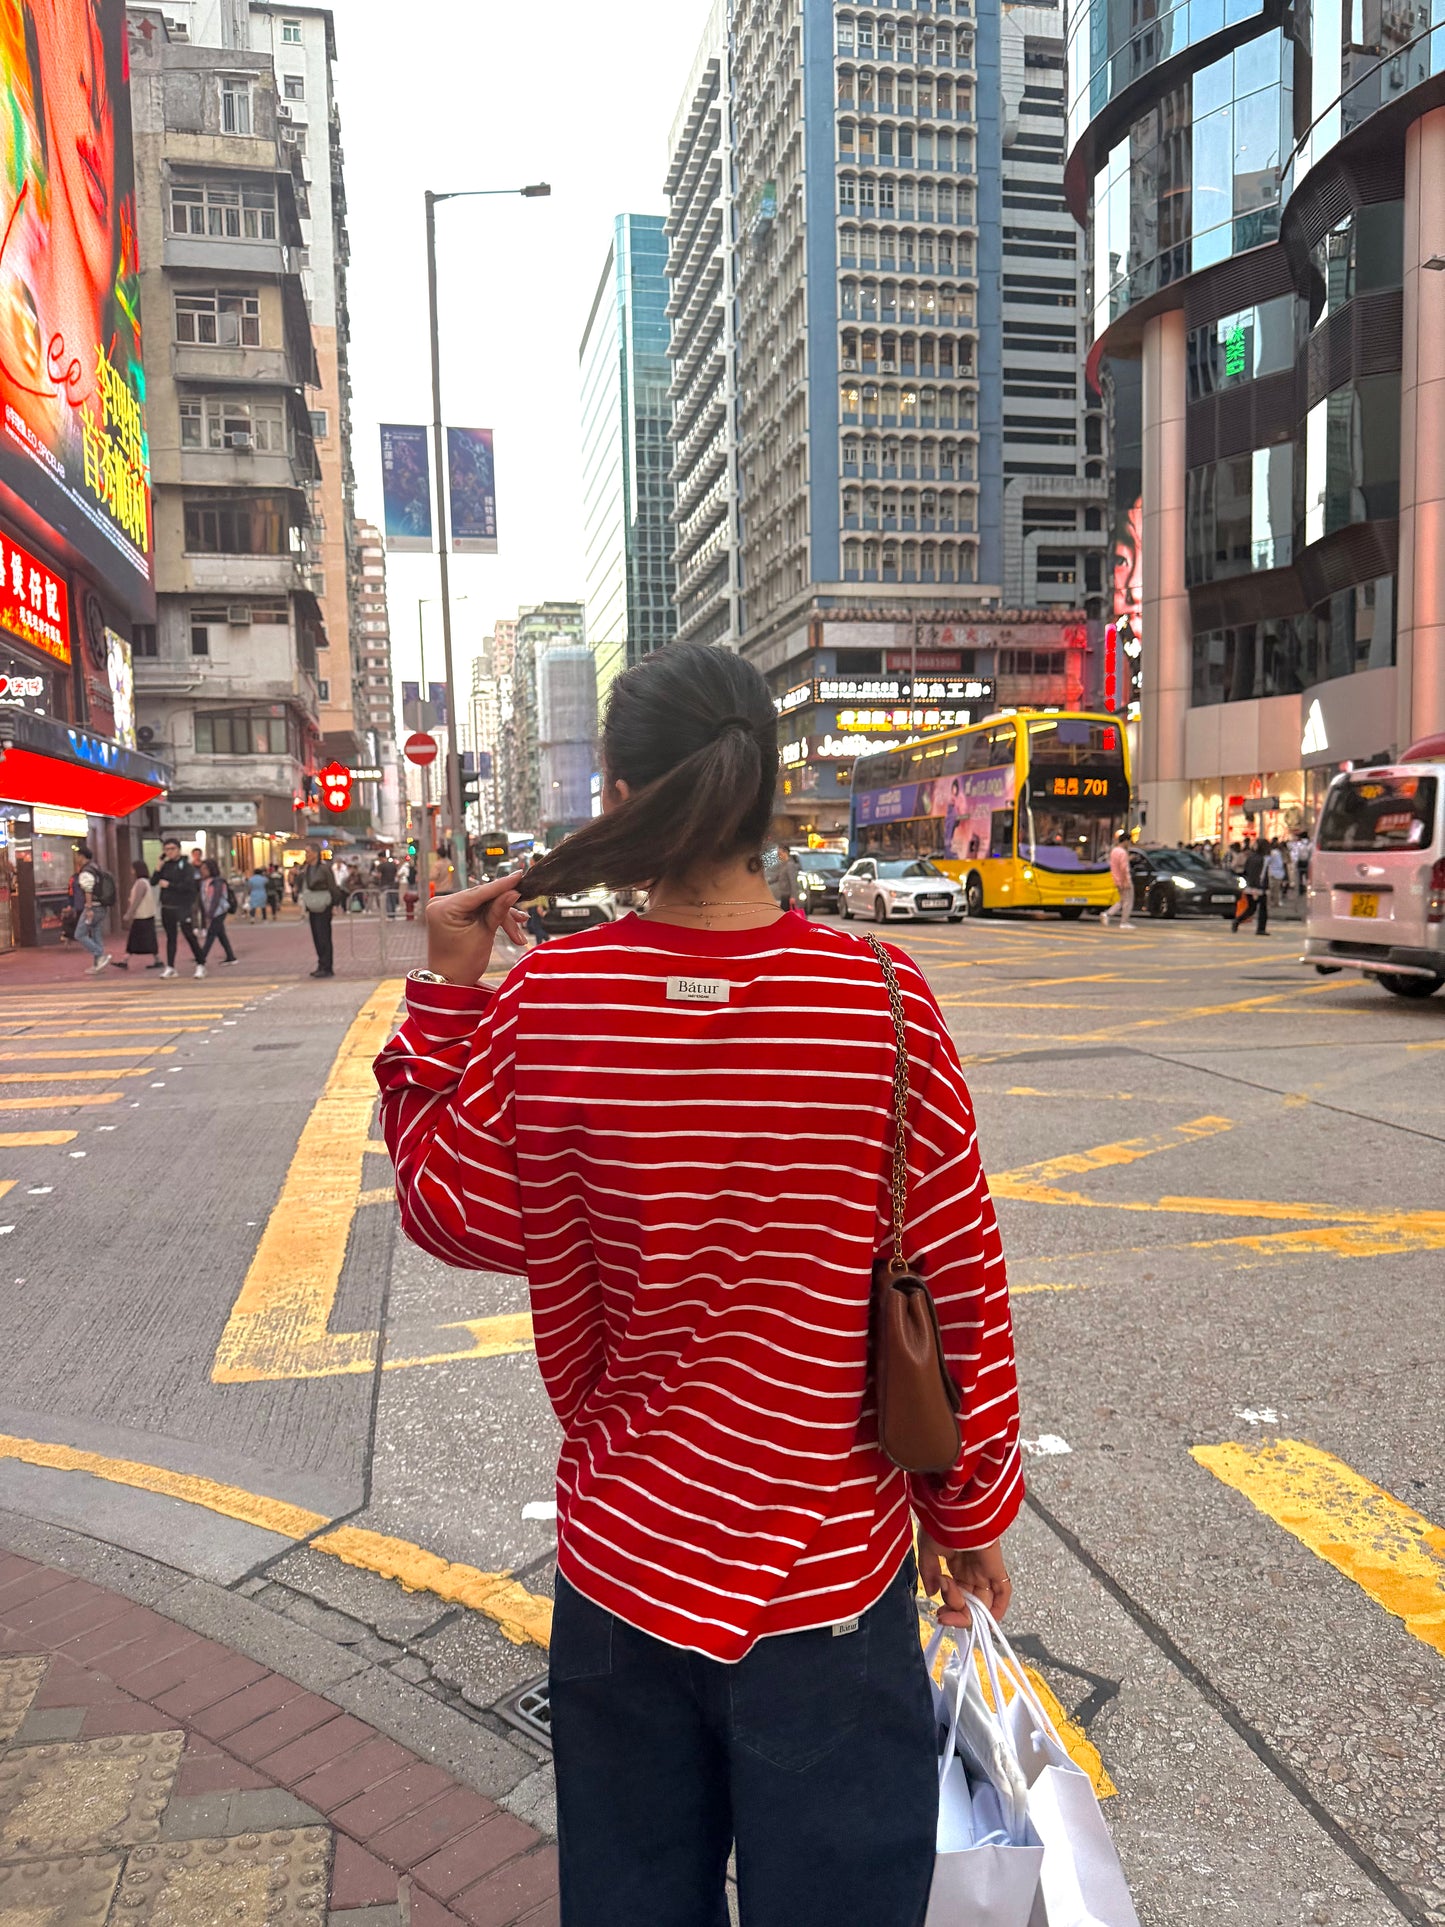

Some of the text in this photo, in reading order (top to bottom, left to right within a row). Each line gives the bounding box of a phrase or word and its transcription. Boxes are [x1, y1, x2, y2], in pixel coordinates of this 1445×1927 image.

[79, 400, 148, 553] 首秀順利
[1083, 778, 1108, 796] 701
[678, 980, 719, 994] Bátur
